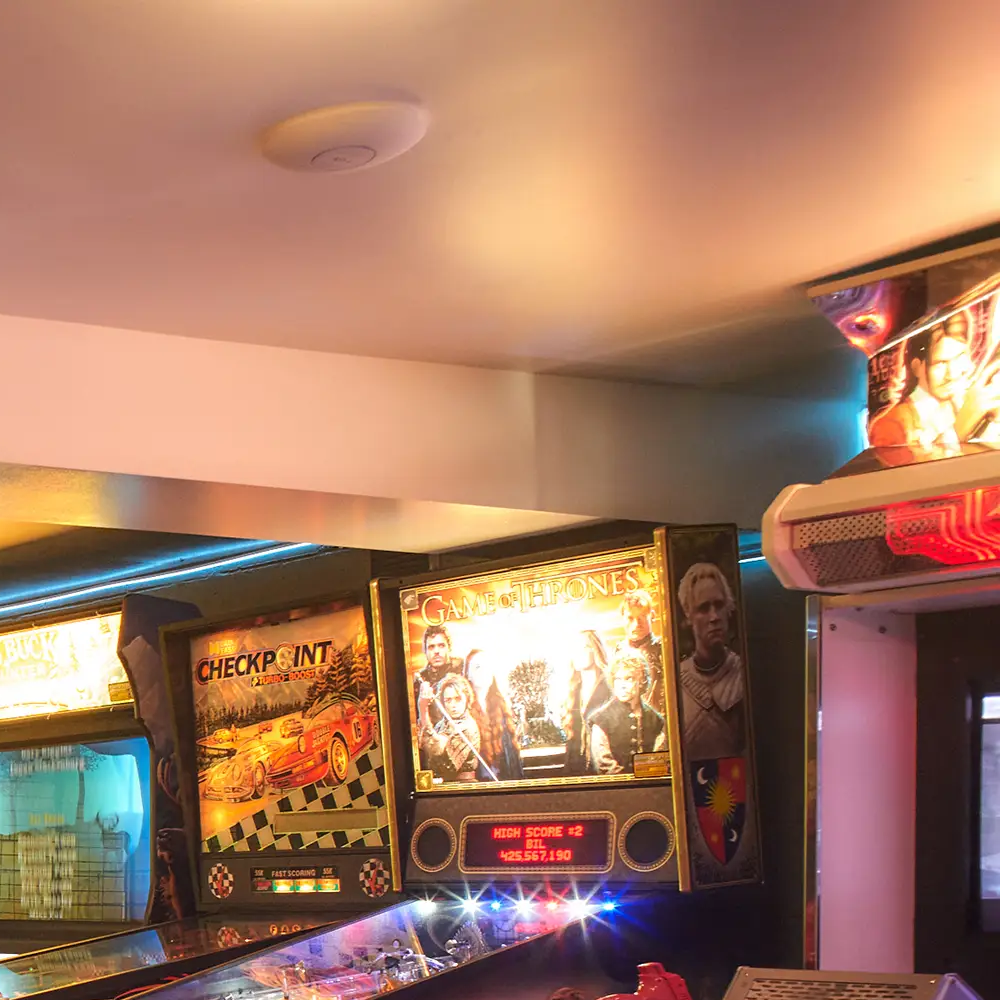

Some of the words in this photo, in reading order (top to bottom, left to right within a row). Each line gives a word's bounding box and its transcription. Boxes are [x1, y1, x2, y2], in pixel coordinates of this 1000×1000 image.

[422, 590, 497, 627] GAME
[498, 590, 518, 609] OF
[512, 563, 641, 613] THRONES
[4, 631, 58, 662] BUCK
[197, 641, 333, 683] CHECKPOINT
[493, 827, 521, 838] HIGH
[525, 827, 563, 837] SCORE
[567, 825, 583, 836] #2
[526, 839, 546, 849] BIL
[500, 850, 572, 861] 425,567,190
[287, 869, 316, 877] SCORING
